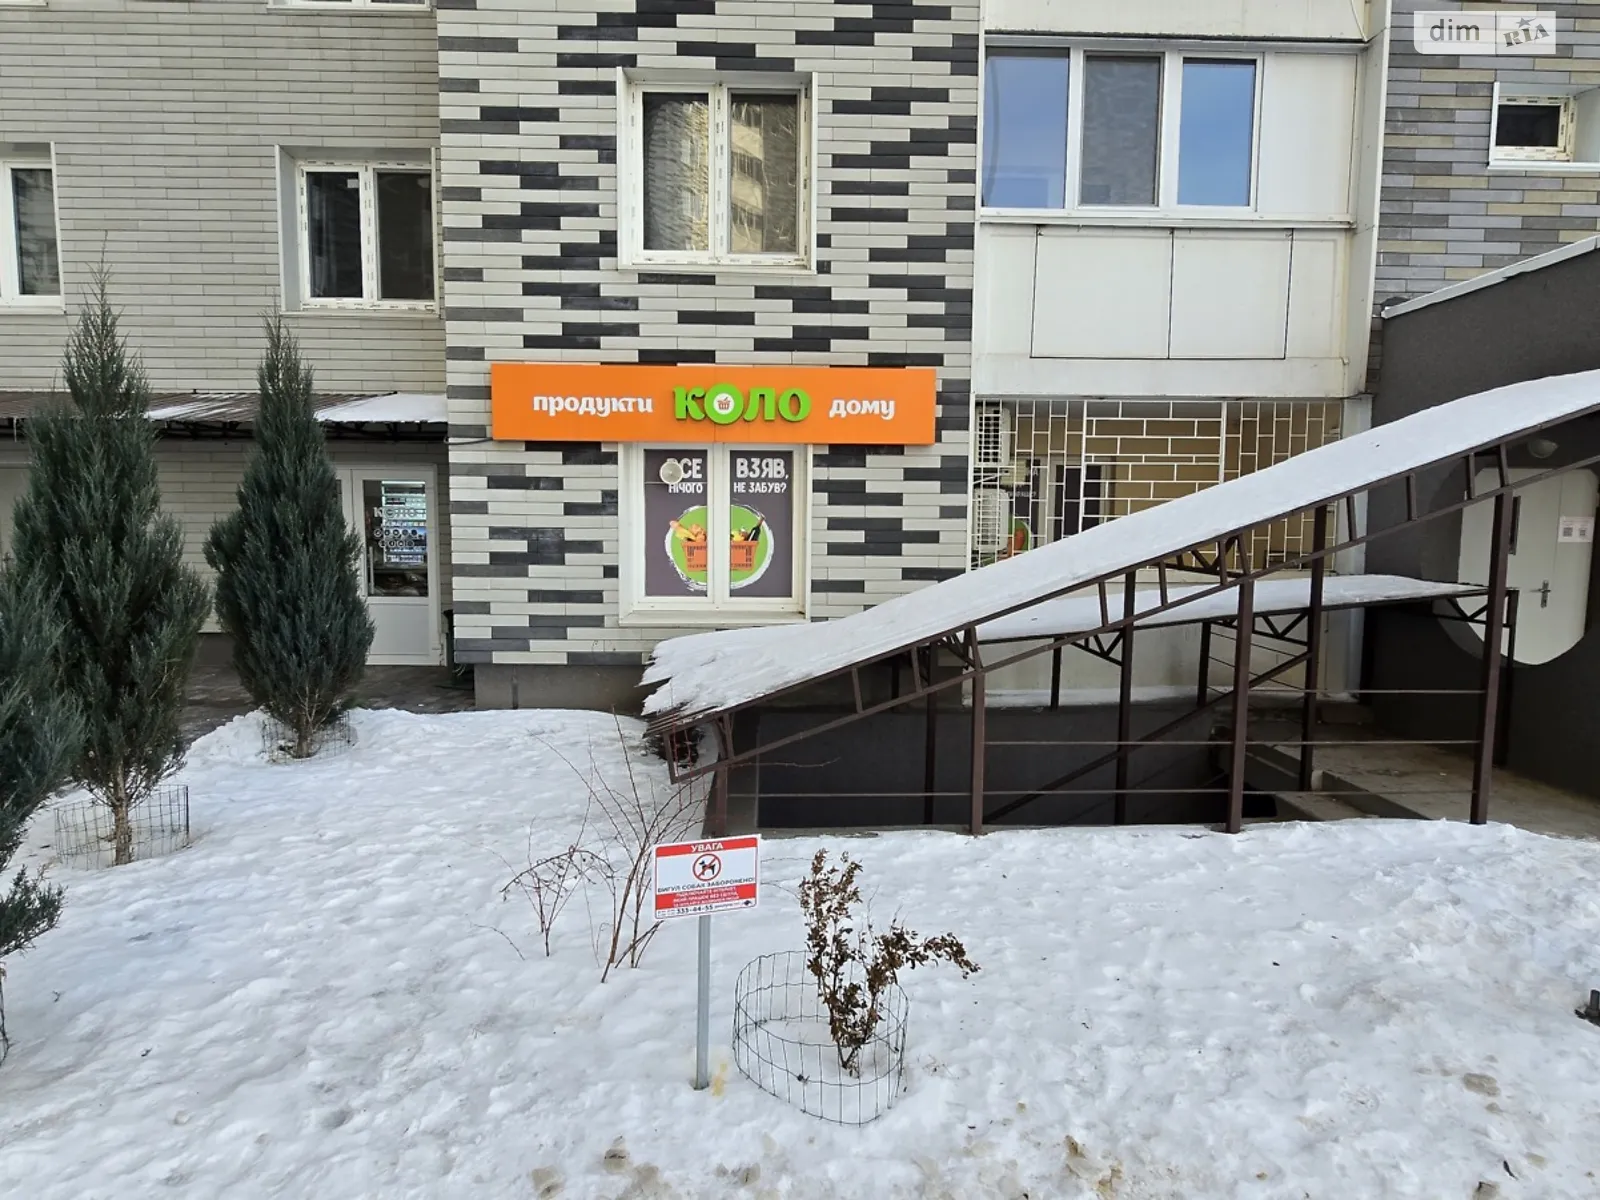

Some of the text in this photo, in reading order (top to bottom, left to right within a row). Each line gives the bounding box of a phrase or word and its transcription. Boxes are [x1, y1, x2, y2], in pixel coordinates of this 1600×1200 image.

[533, 383, 896, 425] продукти КОЛО дому
[736, 458, 789, 480] ВЗЯВ,
[733, 482, 746, 494] НЕ
[749, 482, 787, 494] ЗАБУВ?
[690, 842, 724, 853] УВАГА
[681, 882, 706, 891] СОБАК
